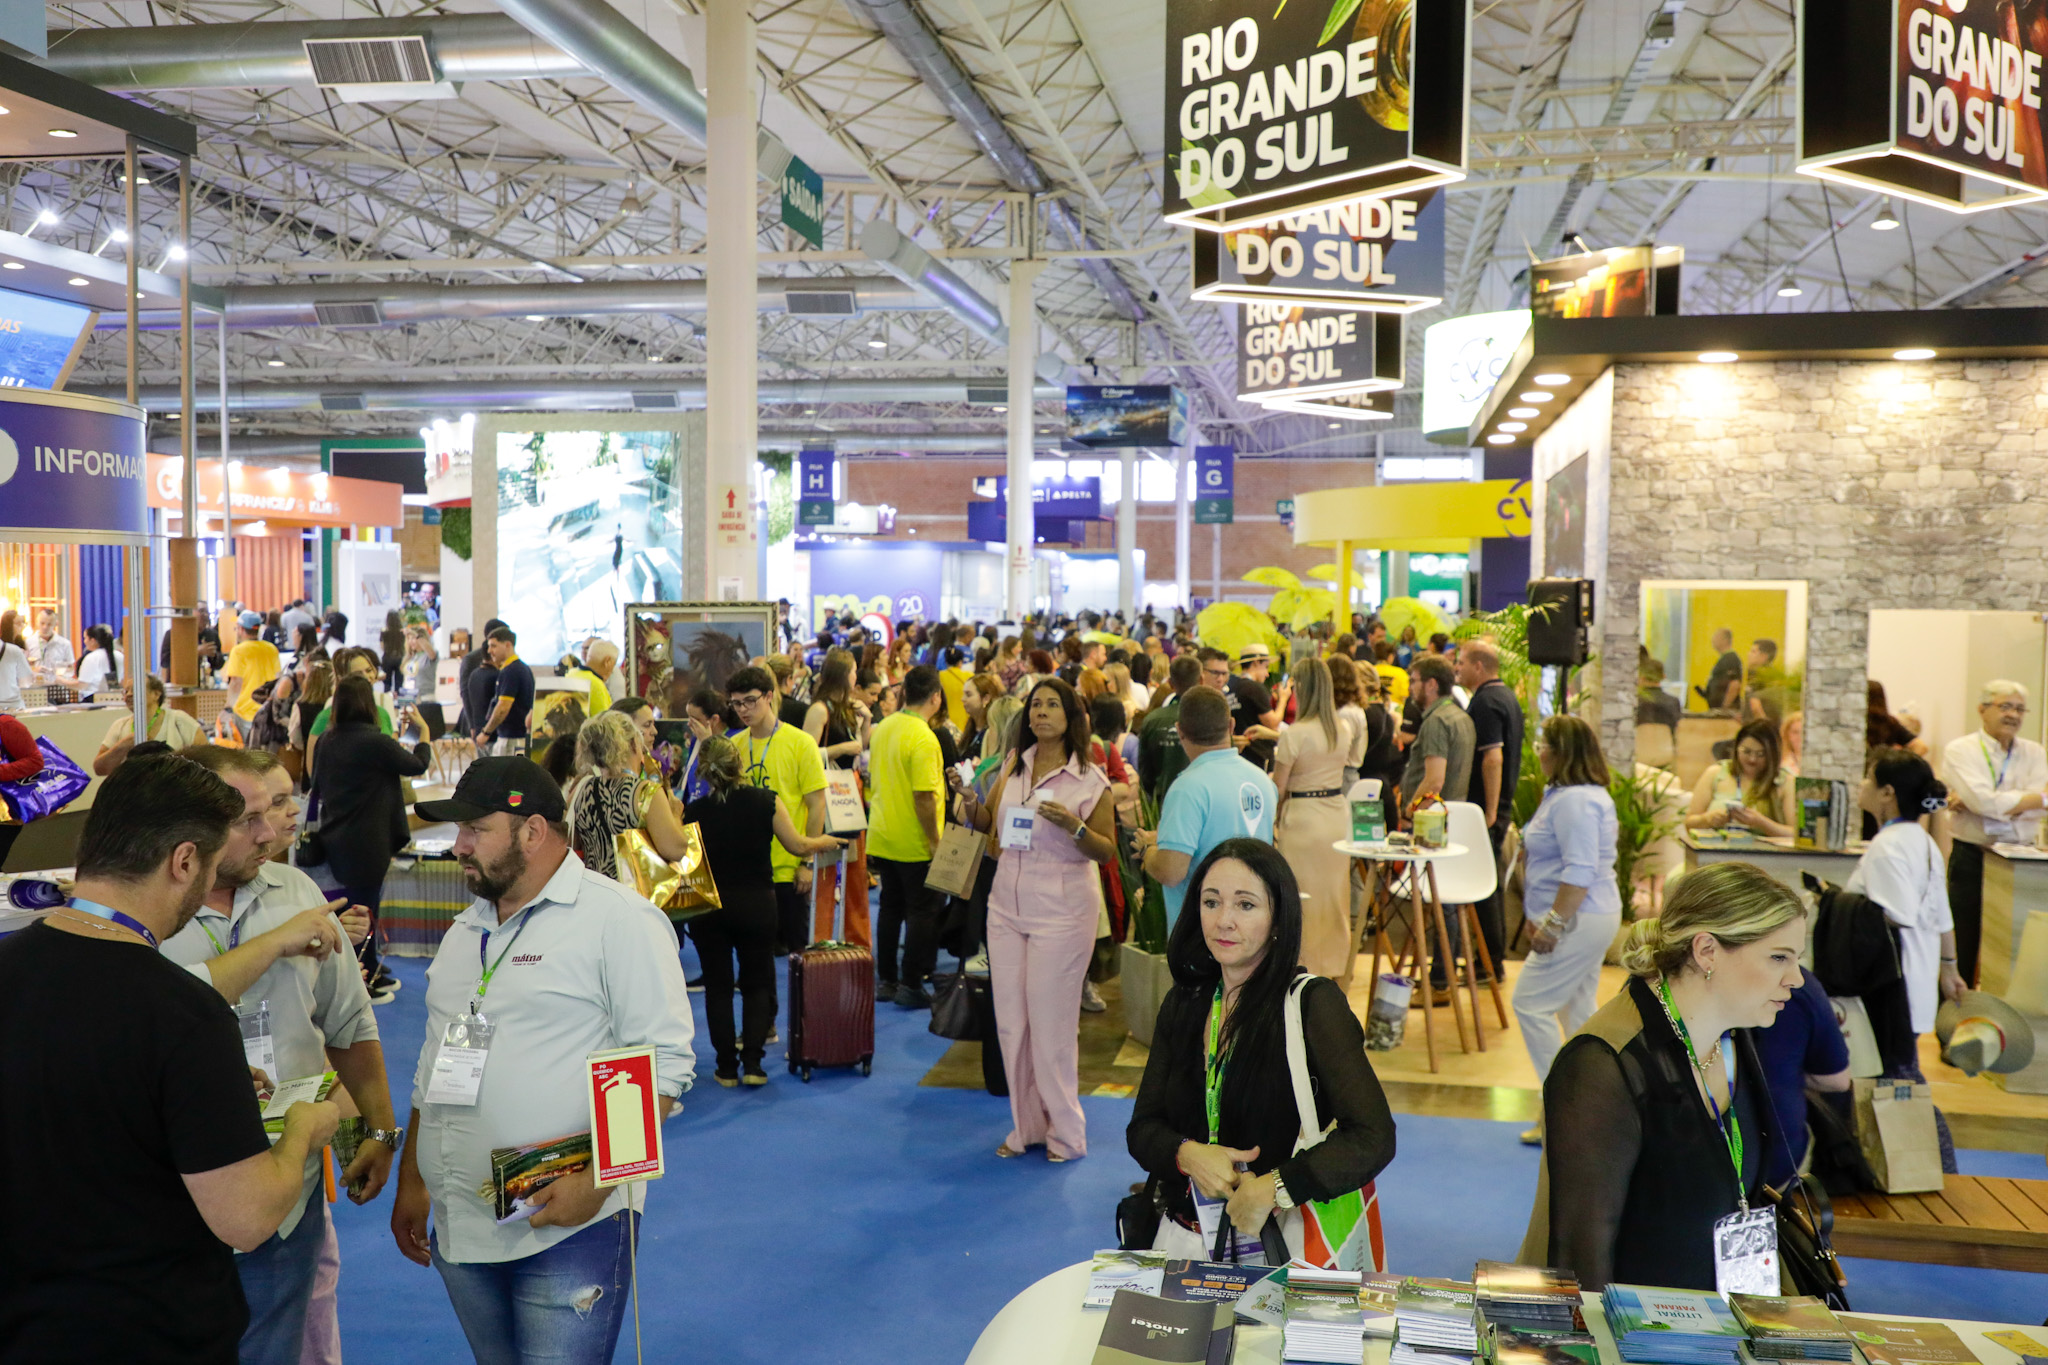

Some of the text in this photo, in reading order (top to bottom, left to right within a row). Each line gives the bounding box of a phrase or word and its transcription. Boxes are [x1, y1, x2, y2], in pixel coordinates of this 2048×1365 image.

[1182, 17, 1259, 87] RIO
[1907, 7, 2042, 109] GRANDE
[1179, 36, 1378, 142] GRANDE
[1906, 74, 2024, 168] DO SUL
[1179, 111, 1349, 199] DO SUL
[1250, 199, 1418, 242] ANDE
[1236, 233, 1396, 285] DO SUL
[1245, 313, 1357, 356] GRANDE
[1246, 304, 1292, 326] RIO
[1246, 349, 1342, 388] DO SUL
[809, 473, 824, 489] H
[1061, 490, 1092, 499] DELTA
[1205, 469, 1223, 486] G
[899, 595, 924, 617] 20
[1131, 1318, 1173, 1335] hotel
[1654, 1310, 1702, 1319] LITORAL
[1917, 1352, 1958, 1361] ROTAS
